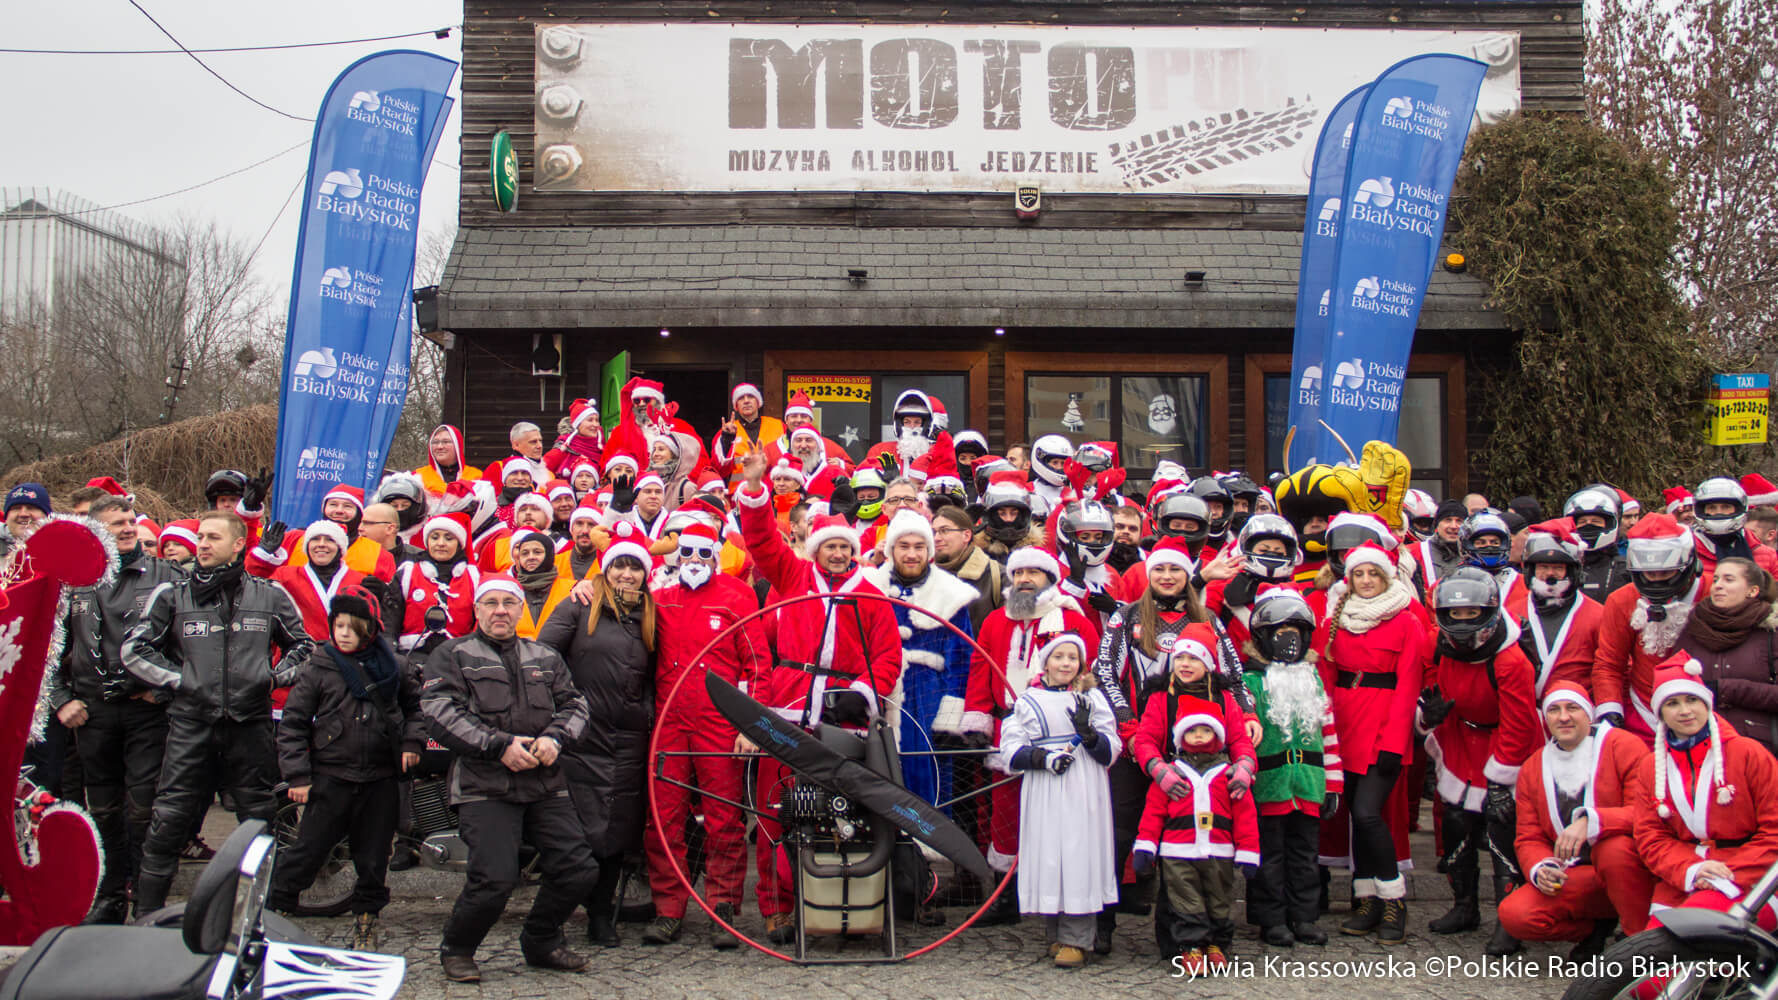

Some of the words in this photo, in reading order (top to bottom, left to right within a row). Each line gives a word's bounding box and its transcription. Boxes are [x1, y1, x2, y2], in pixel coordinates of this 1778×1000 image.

[728, 38, 1136, 131] MOTO
[381, 106, 417, 125] Radio
[383, 95, 420, 114] Polskie
[1415, 99, 1450, 118] Polskie
[347, 107, 415, 136] Białystok
[1382, 114, 1444, 141] Białystok
[1413, 111, 1448, 130] Radio
[728, 149, 831, 172] MUZYKA
[851, 150, 959, 172] ALKOHOL
[980, 150, 1099, 174] JEDZENIE
[367, 174, 419, 199] Polskie
[1398, 181, 1444, 205] Polskie
[316, 195, 411, 231] Białystok
[364, 190, 415, 215] Radio
[1395, 198, 1440, 221] Radio
[1351, 203, 1435, 238] Białystok
[1382, 279, 1416, 294] Polskie
[1351, 296, 1410, 318] Białystok
[1379, 291, 1414, 306] Radio
[337, 368, 375, 387] Radio
[385, 362, 410, 377] skie
[292, 376, 371, 404] Białystok
[1736, 376, 1754, 387] TAXI
[789, 386, 871, 401] -732-32-32
[1331, 387, 1399, 412] Białystok
[316, 458, 345, 471] Radio
